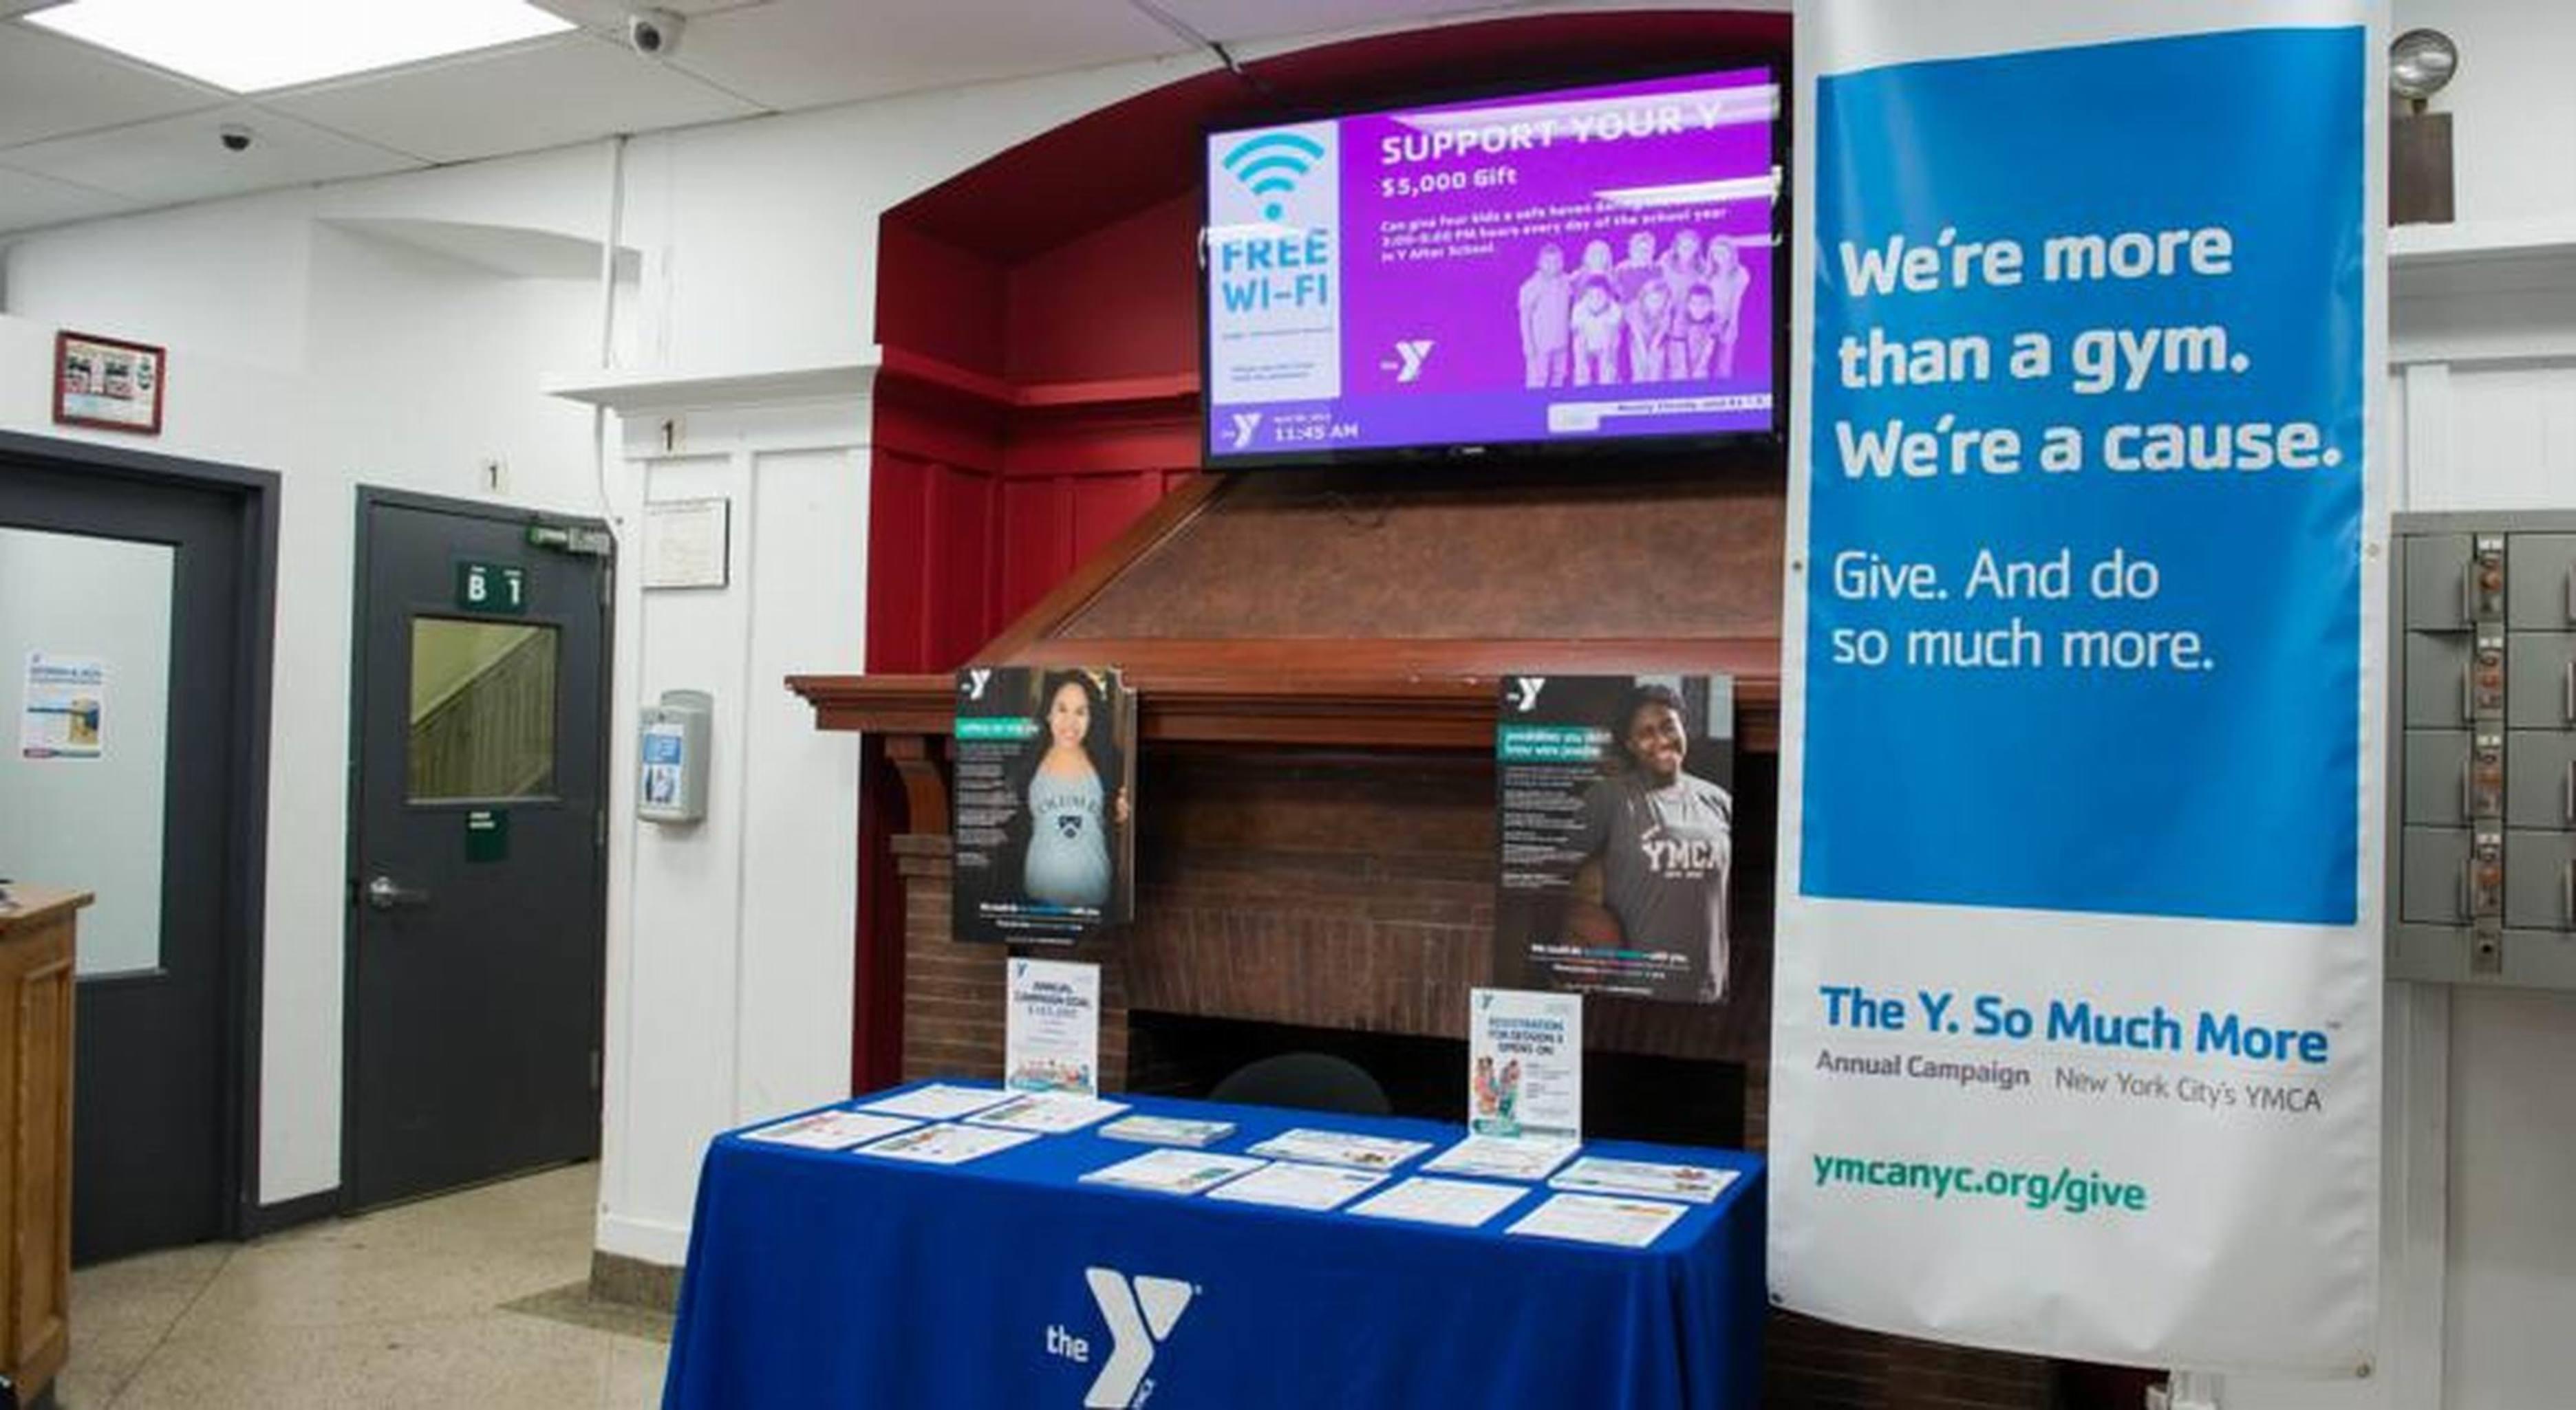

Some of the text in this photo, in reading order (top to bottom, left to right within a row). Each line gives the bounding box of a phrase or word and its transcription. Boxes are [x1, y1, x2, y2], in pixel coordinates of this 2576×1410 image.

[1380, 100, 1721, 165] SUPPORT YOUR Y
[1381, 165, 1518, 200] $5,000 Gift
[1221, 228, 1329, 272] FREE
[1838, 226, 2233, 297] We're more
[1221, 272, 1328, 314] WI-FI
[1838, 325, 2251, 395] than a gym.
[1275, 422, 1360, 442] 11:45 AM
[1835, 414, 2341, 479] We're a cause.
[469, 575, 520, 604] B 1
[1832, 547, 2160, 600] Give. And do
[1832, 618, 2214, 670] so much more.
[1819, 985, 2329, 1064] The Y. So Much More
[1816, 1048, 2031, 1090] Annual Campaign
[2055, 1066, 2322, 1113] New York City's YMCA
[1812, 1152, 2149, 1215] ymcanyc.org/give
[1046, 1324, 1089, 1363] the
